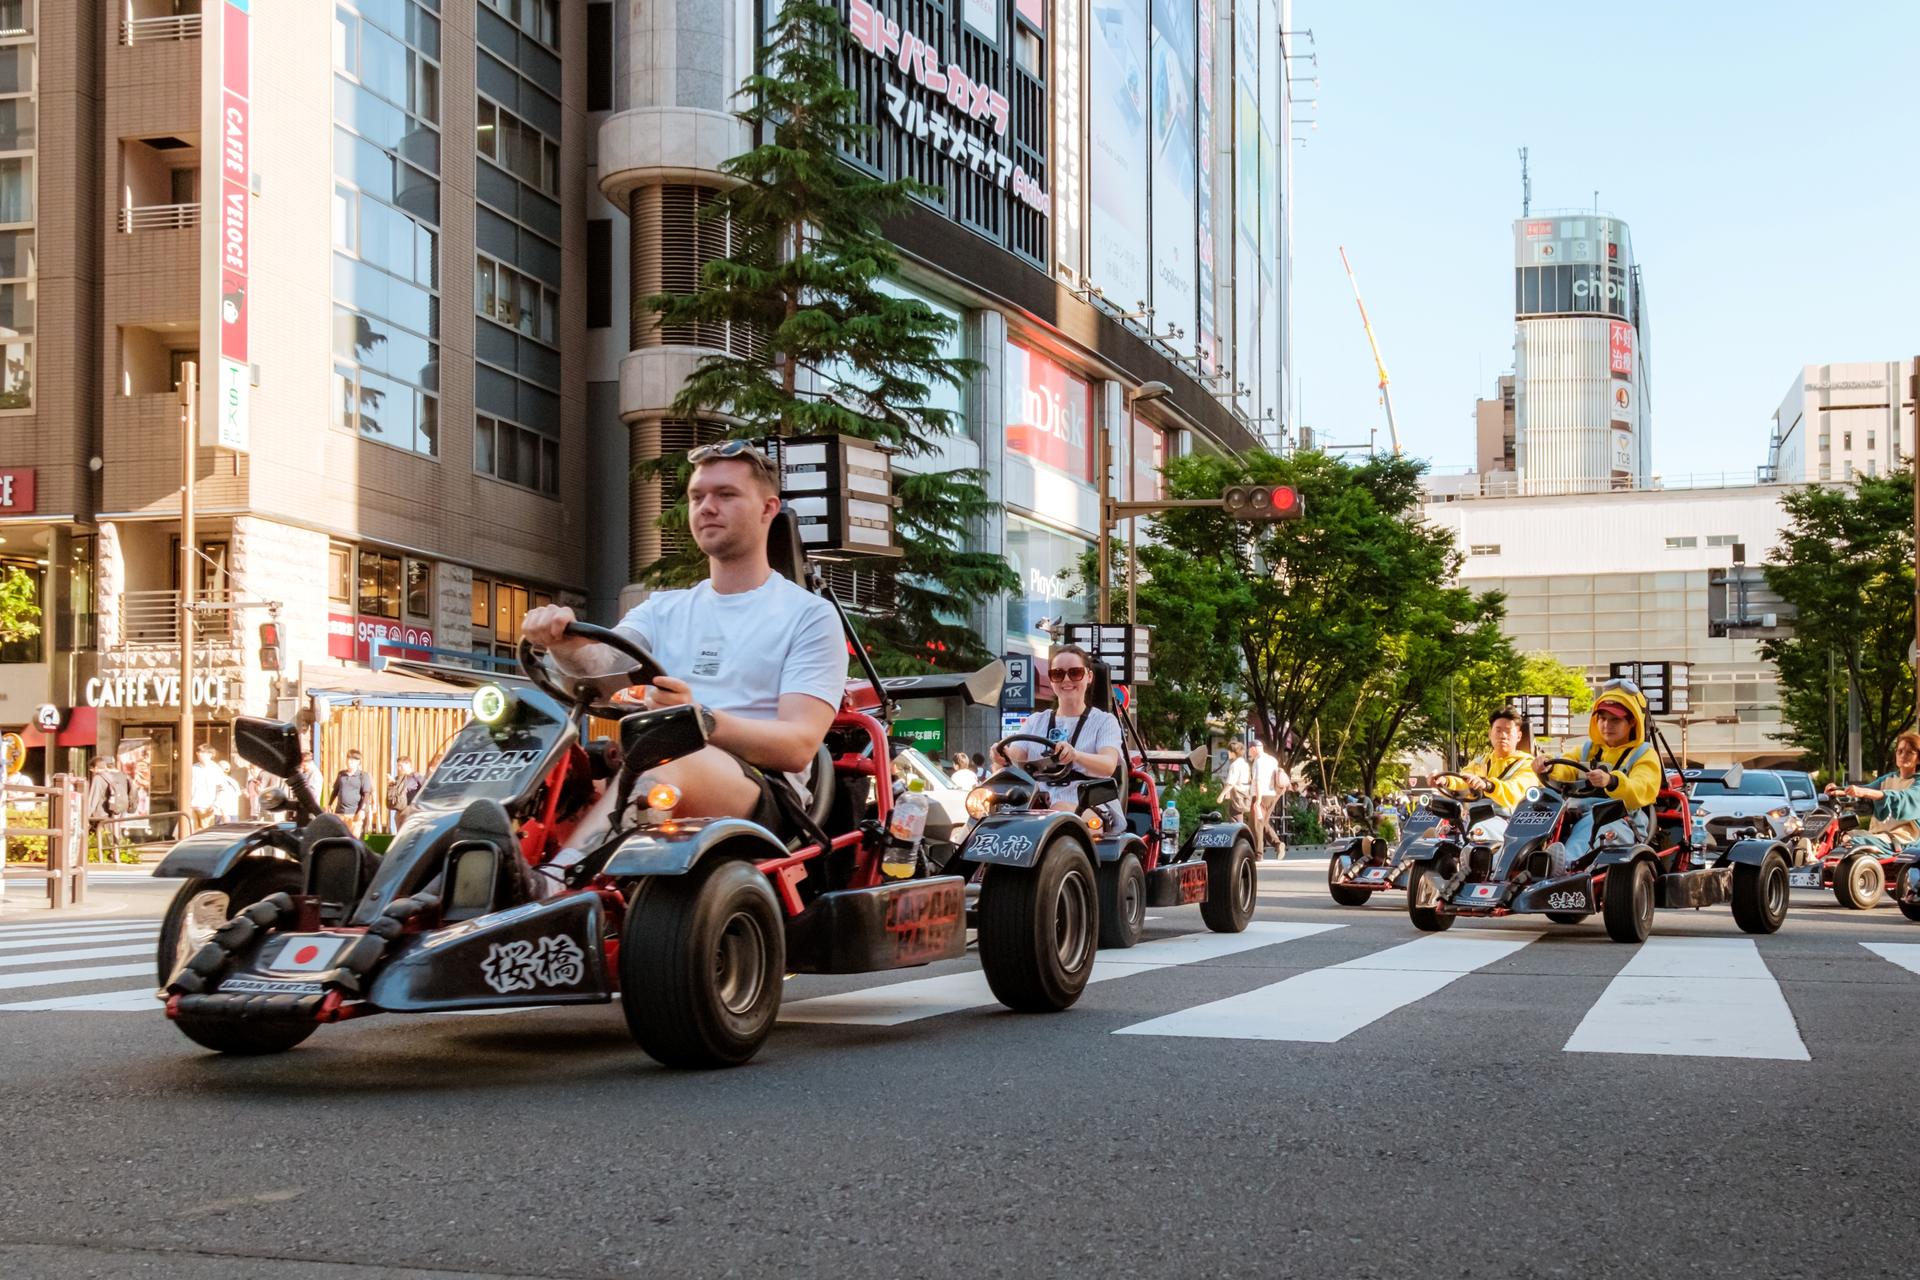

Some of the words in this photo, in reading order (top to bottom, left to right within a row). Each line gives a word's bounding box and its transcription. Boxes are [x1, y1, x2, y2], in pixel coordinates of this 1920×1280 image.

[849, 0, 1010, 137] ヨドバシカメラ
[884, 81, 1013, 189] マルチメディア
[1012, 165, 1049, 218] Akiba
[226, 193, 244, 269] VELOCE
[0, 475, 13, 507] E
[153, 676, 229, 708] VEOCE
[1005, 685, 1026, 698] TX
[439, 766, 525, 783] KART
[440, 750, 544, 769] JAPAN
[968, 833, 1033, 860] 風神
[481, 934, 585, 994] 桜橋
[219, 980, 264, 992] JAPAN
